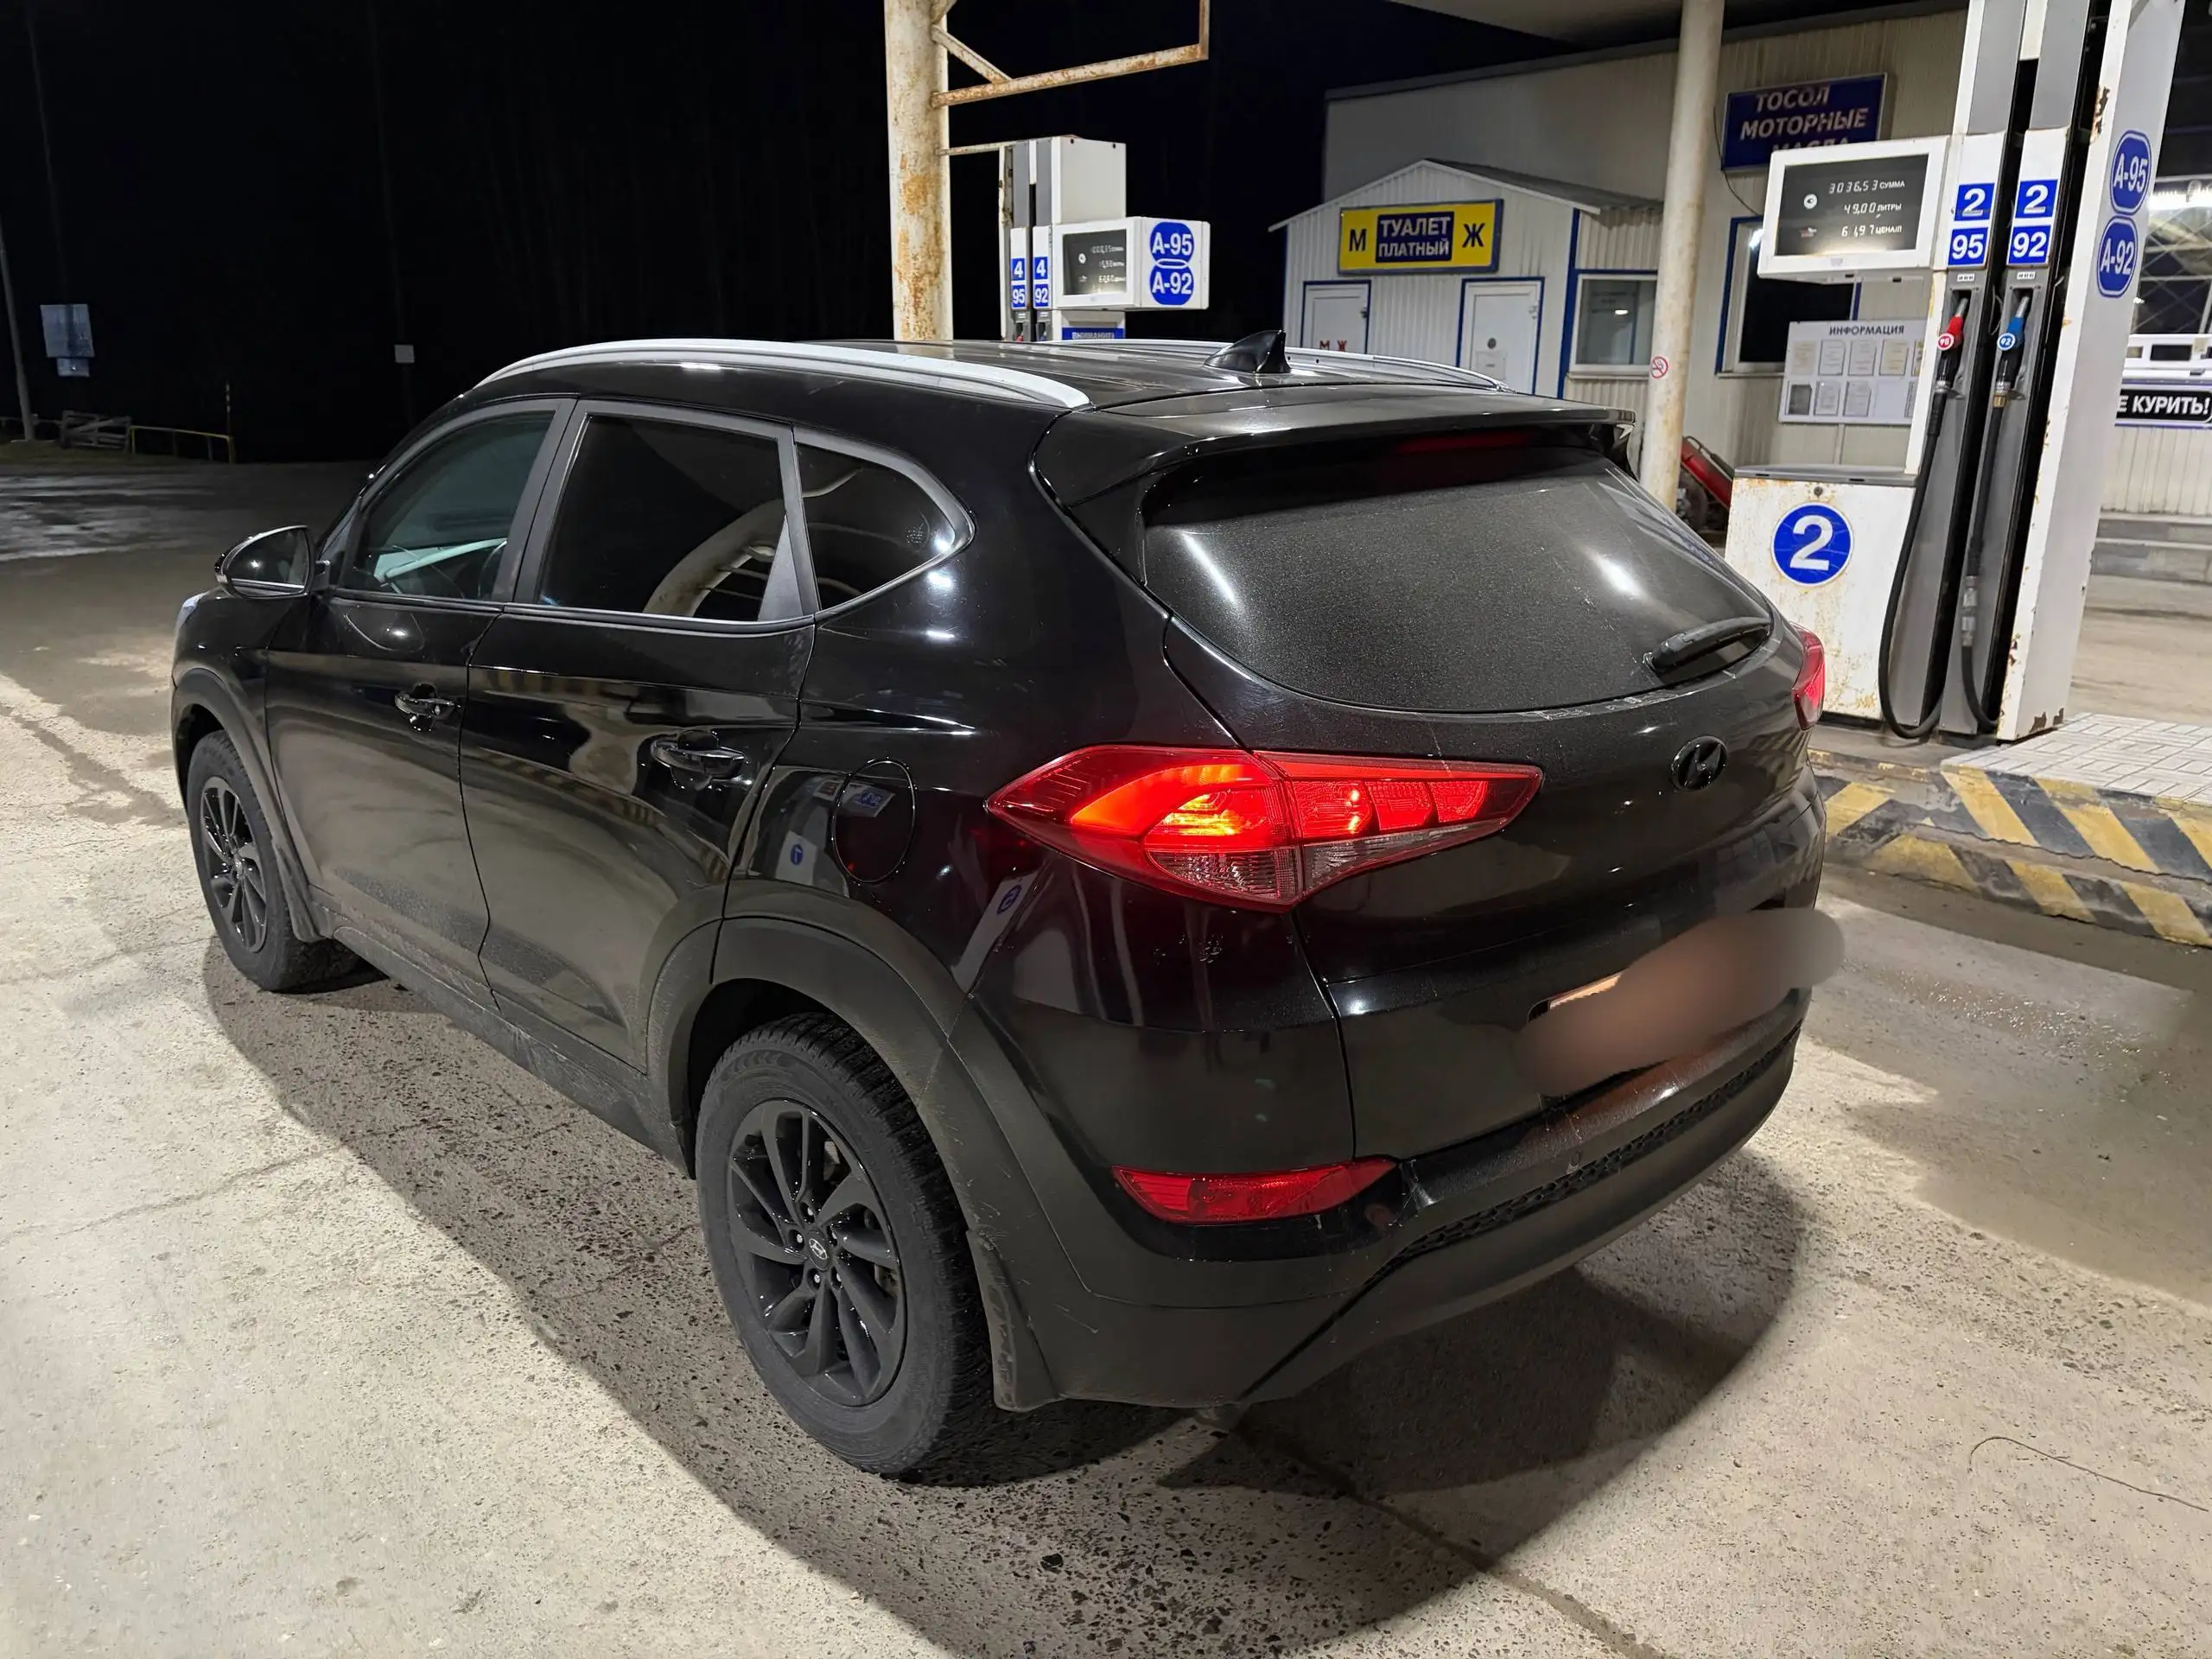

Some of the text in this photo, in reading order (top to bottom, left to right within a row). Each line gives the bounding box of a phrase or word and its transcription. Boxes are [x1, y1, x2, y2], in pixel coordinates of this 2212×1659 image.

[1756, 86, 1831, 112] ТОСОЛ
[1739, 107, 1869, 141] МОТОРНЫЕ
[1879, 180, 1905, 190] СУММА
[2113, 153, 2149, 193] А-95
[1877, 203, 1902, 213] ЛИТРЫ
[1961, 188, 1986, 217] 2
[2023, 184, 2049, 214] 2
[1380, 216, 1452, 238] ТУАЛЕТ
[1462, 223, 1485, 248] Ж
[1152, 232, 1192, 256] А-95
[1349, 228, 1367, 252] М
[1378, 238, 1450, 257] ПЛАТНЫЙ
[1951, 233, 1984, 259] 95
[2012, 231, 2047, 257] 92
[1036, 259, 1046, 276] 4
[2100, 238, 2134, 275] А-92
[1014, 261, 1024, 277] 4
[1152, 271, 1192, 295] А-92
[1013, 289, 1025, 304] 95
[1035, 288, 1048, 303] 92
[1828, 325, 1904, 336] ИНФОРМАЦИЯ
[2000, 337, 2012, 346] 92
[2117, 395, 2210, 415] Е КУРИТЬ!
[1789, 514, 1834, 570] 2
